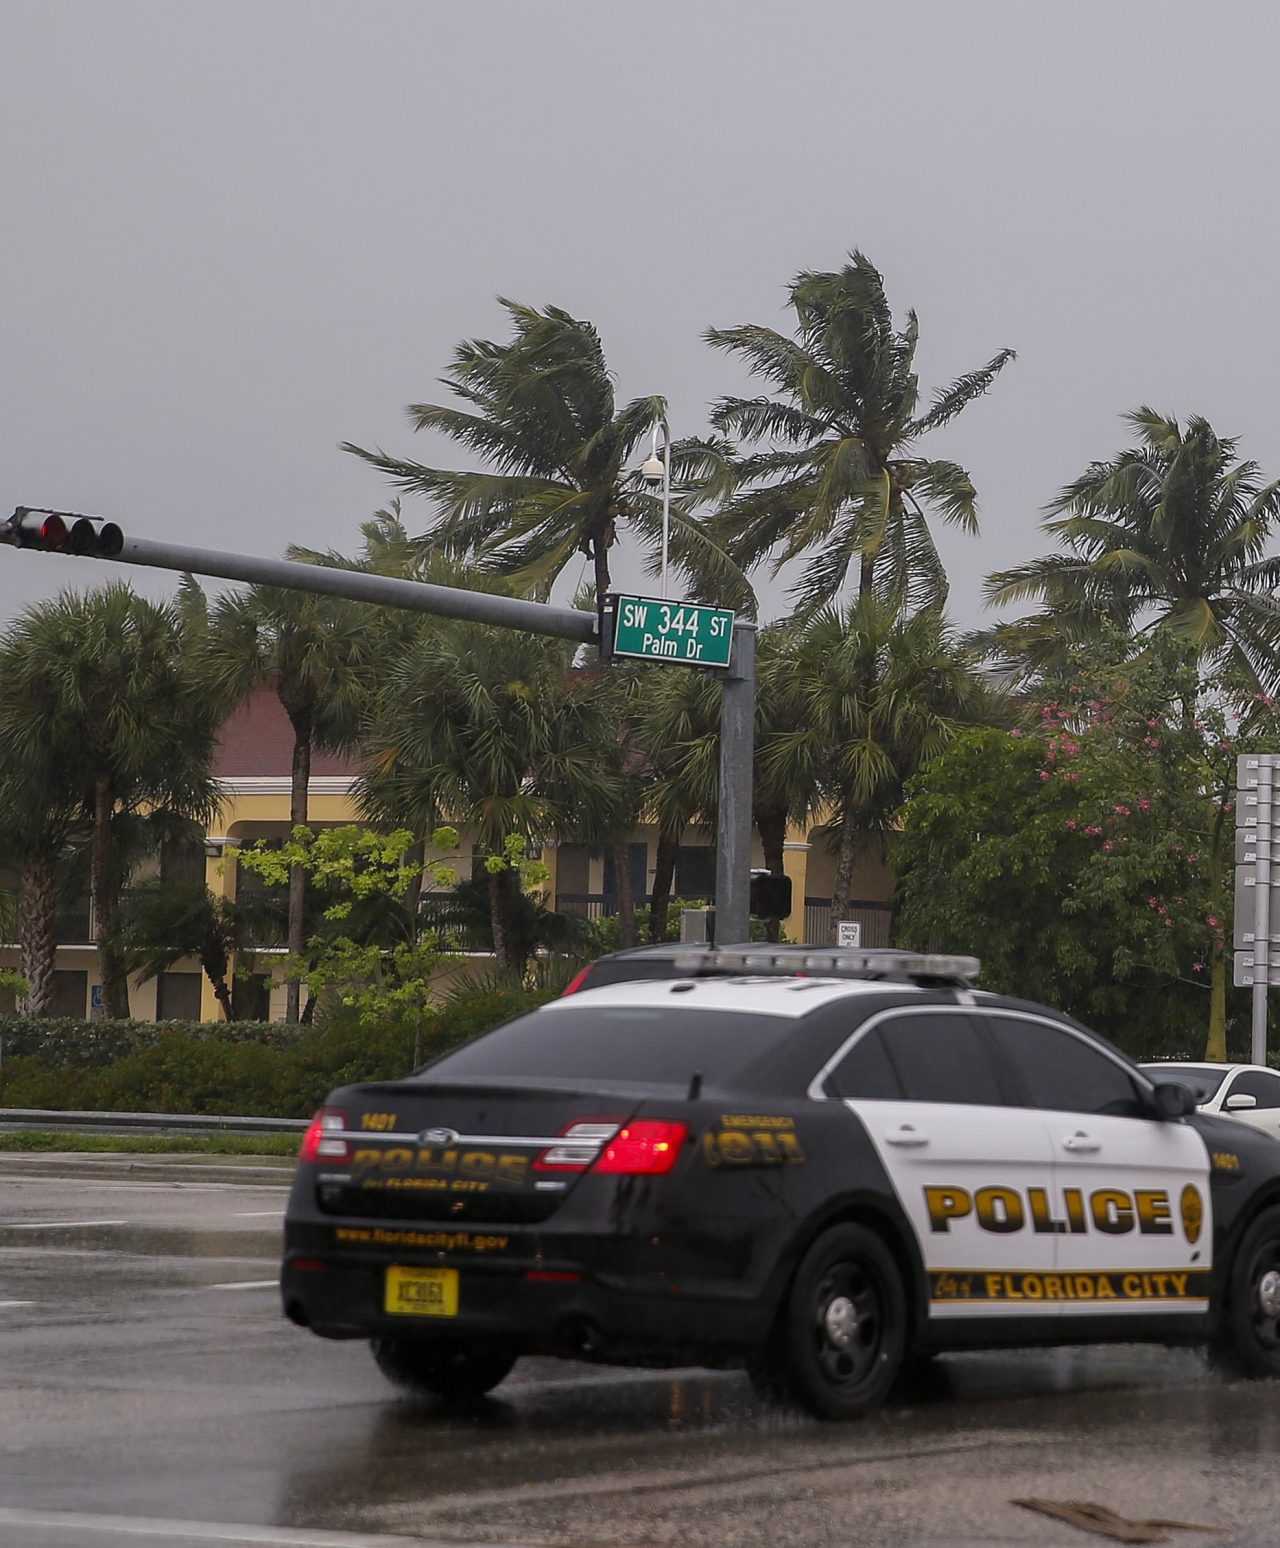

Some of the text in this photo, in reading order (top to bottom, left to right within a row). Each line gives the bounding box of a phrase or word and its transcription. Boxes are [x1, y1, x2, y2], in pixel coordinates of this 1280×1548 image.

[623, 604, 728, 637] SW 344 ST
[642, 633, 703, 659] Palm Dr
[361, 1113, 397, 1131] 1401
[351, 1147, 529, 1185] POLICE
[386, 1177, 448, 1189] FLORIDA
[451, 1179, 490, 1192] CITY
[923, 1184, 1175, 1235] POLICE
[985, 1273, 1116, 1298] FLORIDA
[1122, 1273, 1190, 1297] CITY
